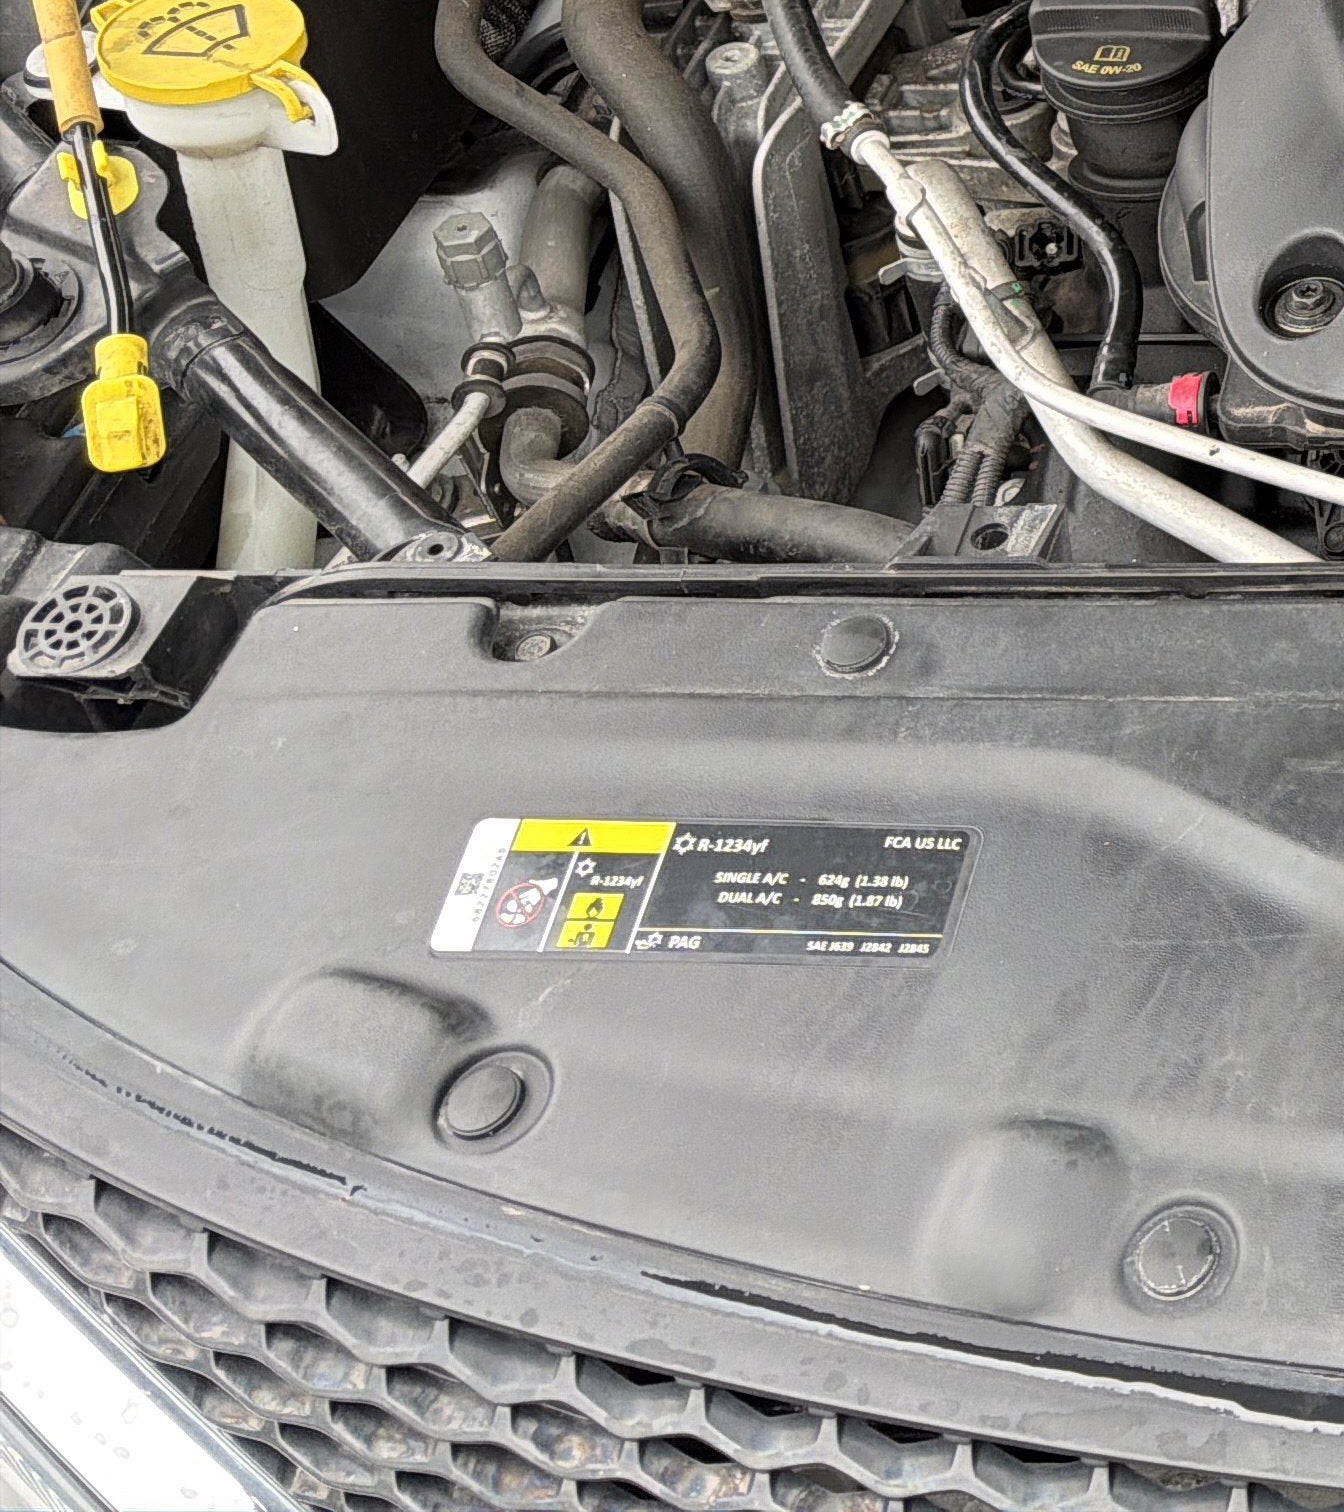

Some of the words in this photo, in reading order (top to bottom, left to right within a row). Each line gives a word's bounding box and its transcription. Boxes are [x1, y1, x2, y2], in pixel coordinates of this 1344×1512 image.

[1071, 60, 1100, 74] SAE
[697, 837, 770, 856] R-1234yf
[884, 836, 911, 849] FCA
[914, 837, 935, 850] US
[936, 838, 963, 851] LLC
[590, 875, 645, 889] R-1234yf
[714, 871, 762, 885] SINGLE
[762, 872, 790, 887] A/C
[818, 873, 851, 889] 624g
[717, 891, 754, 905] DUAL
[754, 892, 783, 906] A/C
[811, 893, 844, 909] 850g
[667, 935, 702, 950] PAG
[806, 940, 827, 952] SAE
